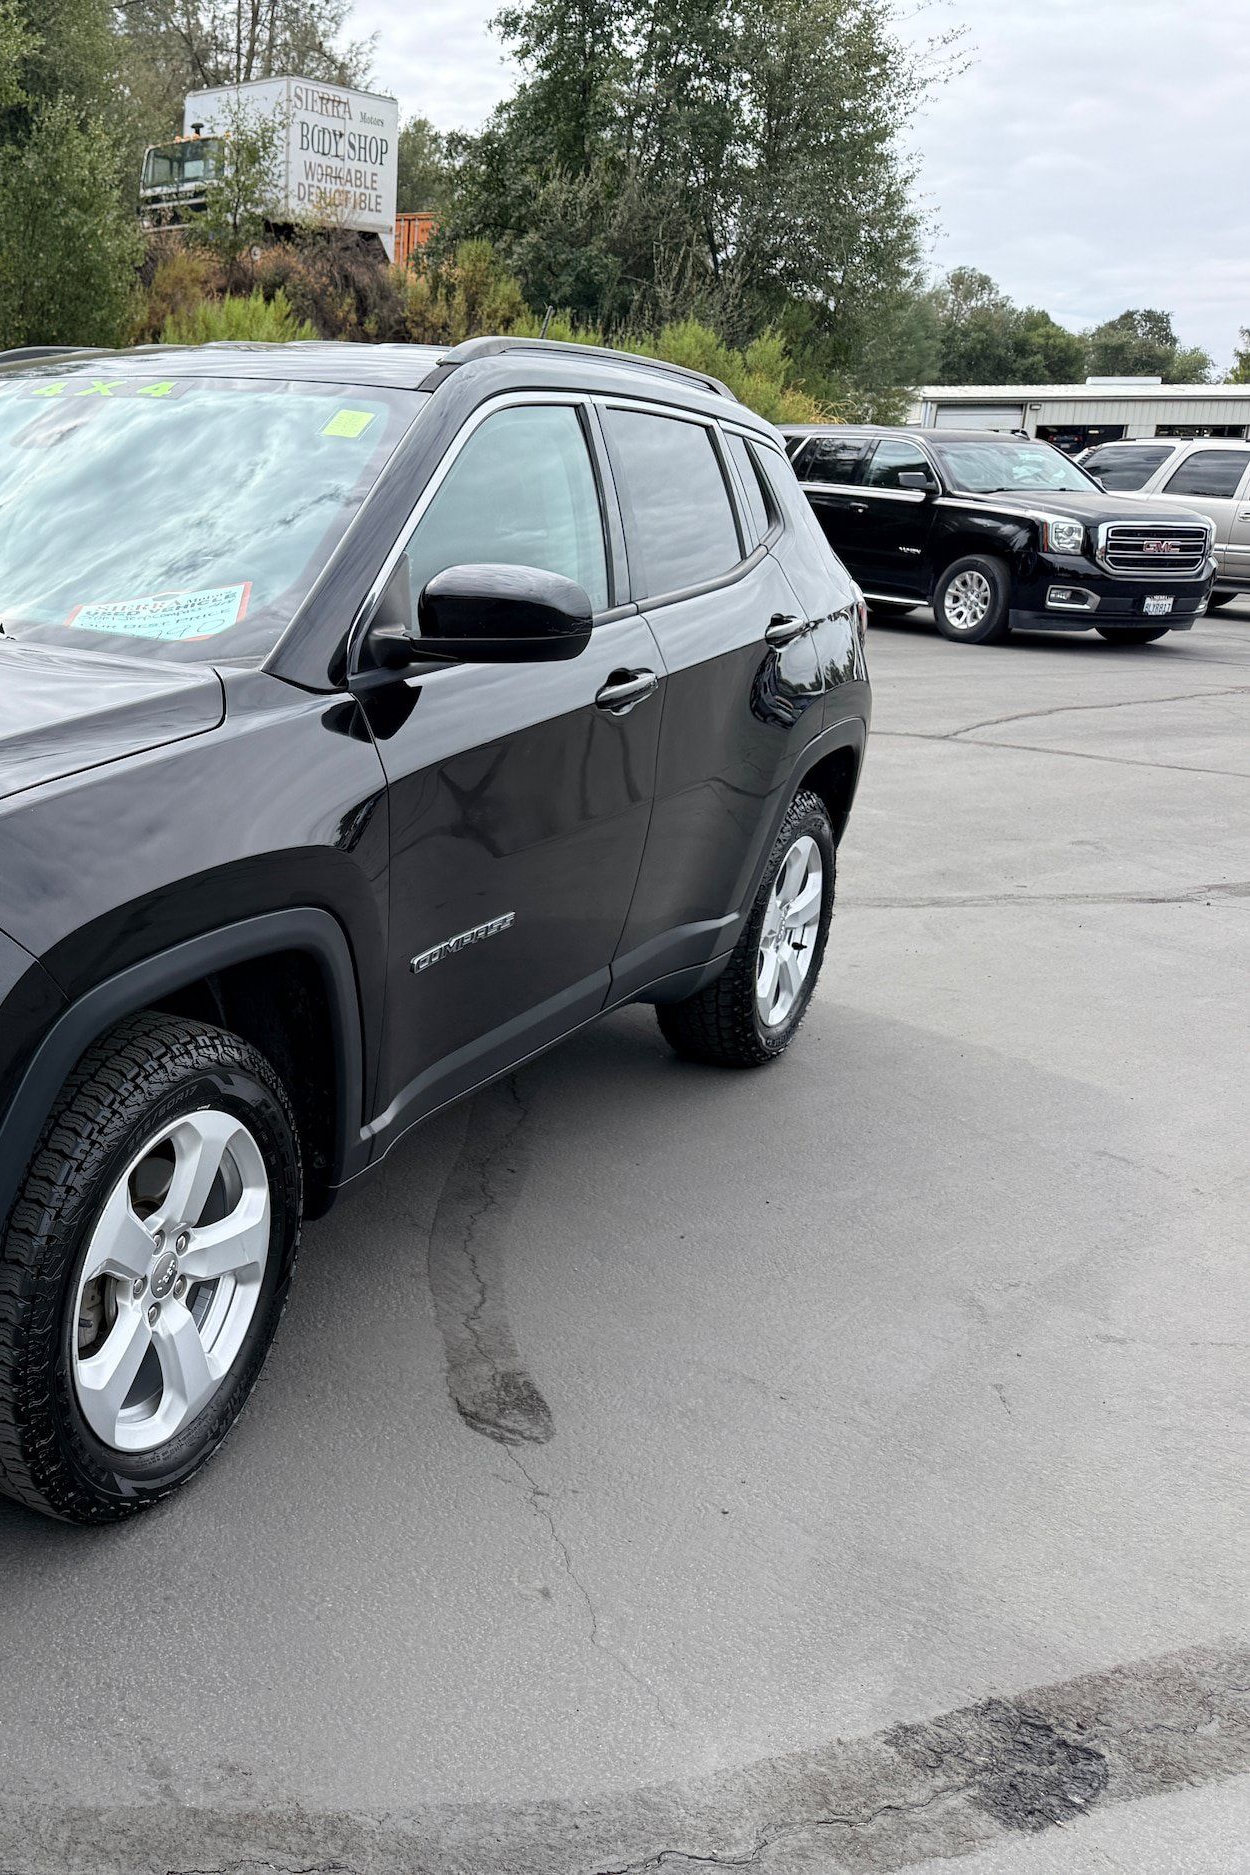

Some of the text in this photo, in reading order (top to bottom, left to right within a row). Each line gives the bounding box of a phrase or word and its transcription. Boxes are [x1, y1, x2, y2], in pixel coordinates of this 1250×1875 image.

[294, 86, 384, 127] SIERRA Motors
[299, 121, 388, 166] BODY SHOP
[303, 160, 378, 191] WORKABLE
[297, 181, 382, 213] DEDUCTIBLE
[1143, 541, 1181, 553] GMC
[410, 911, 516, 974] COMPASS
